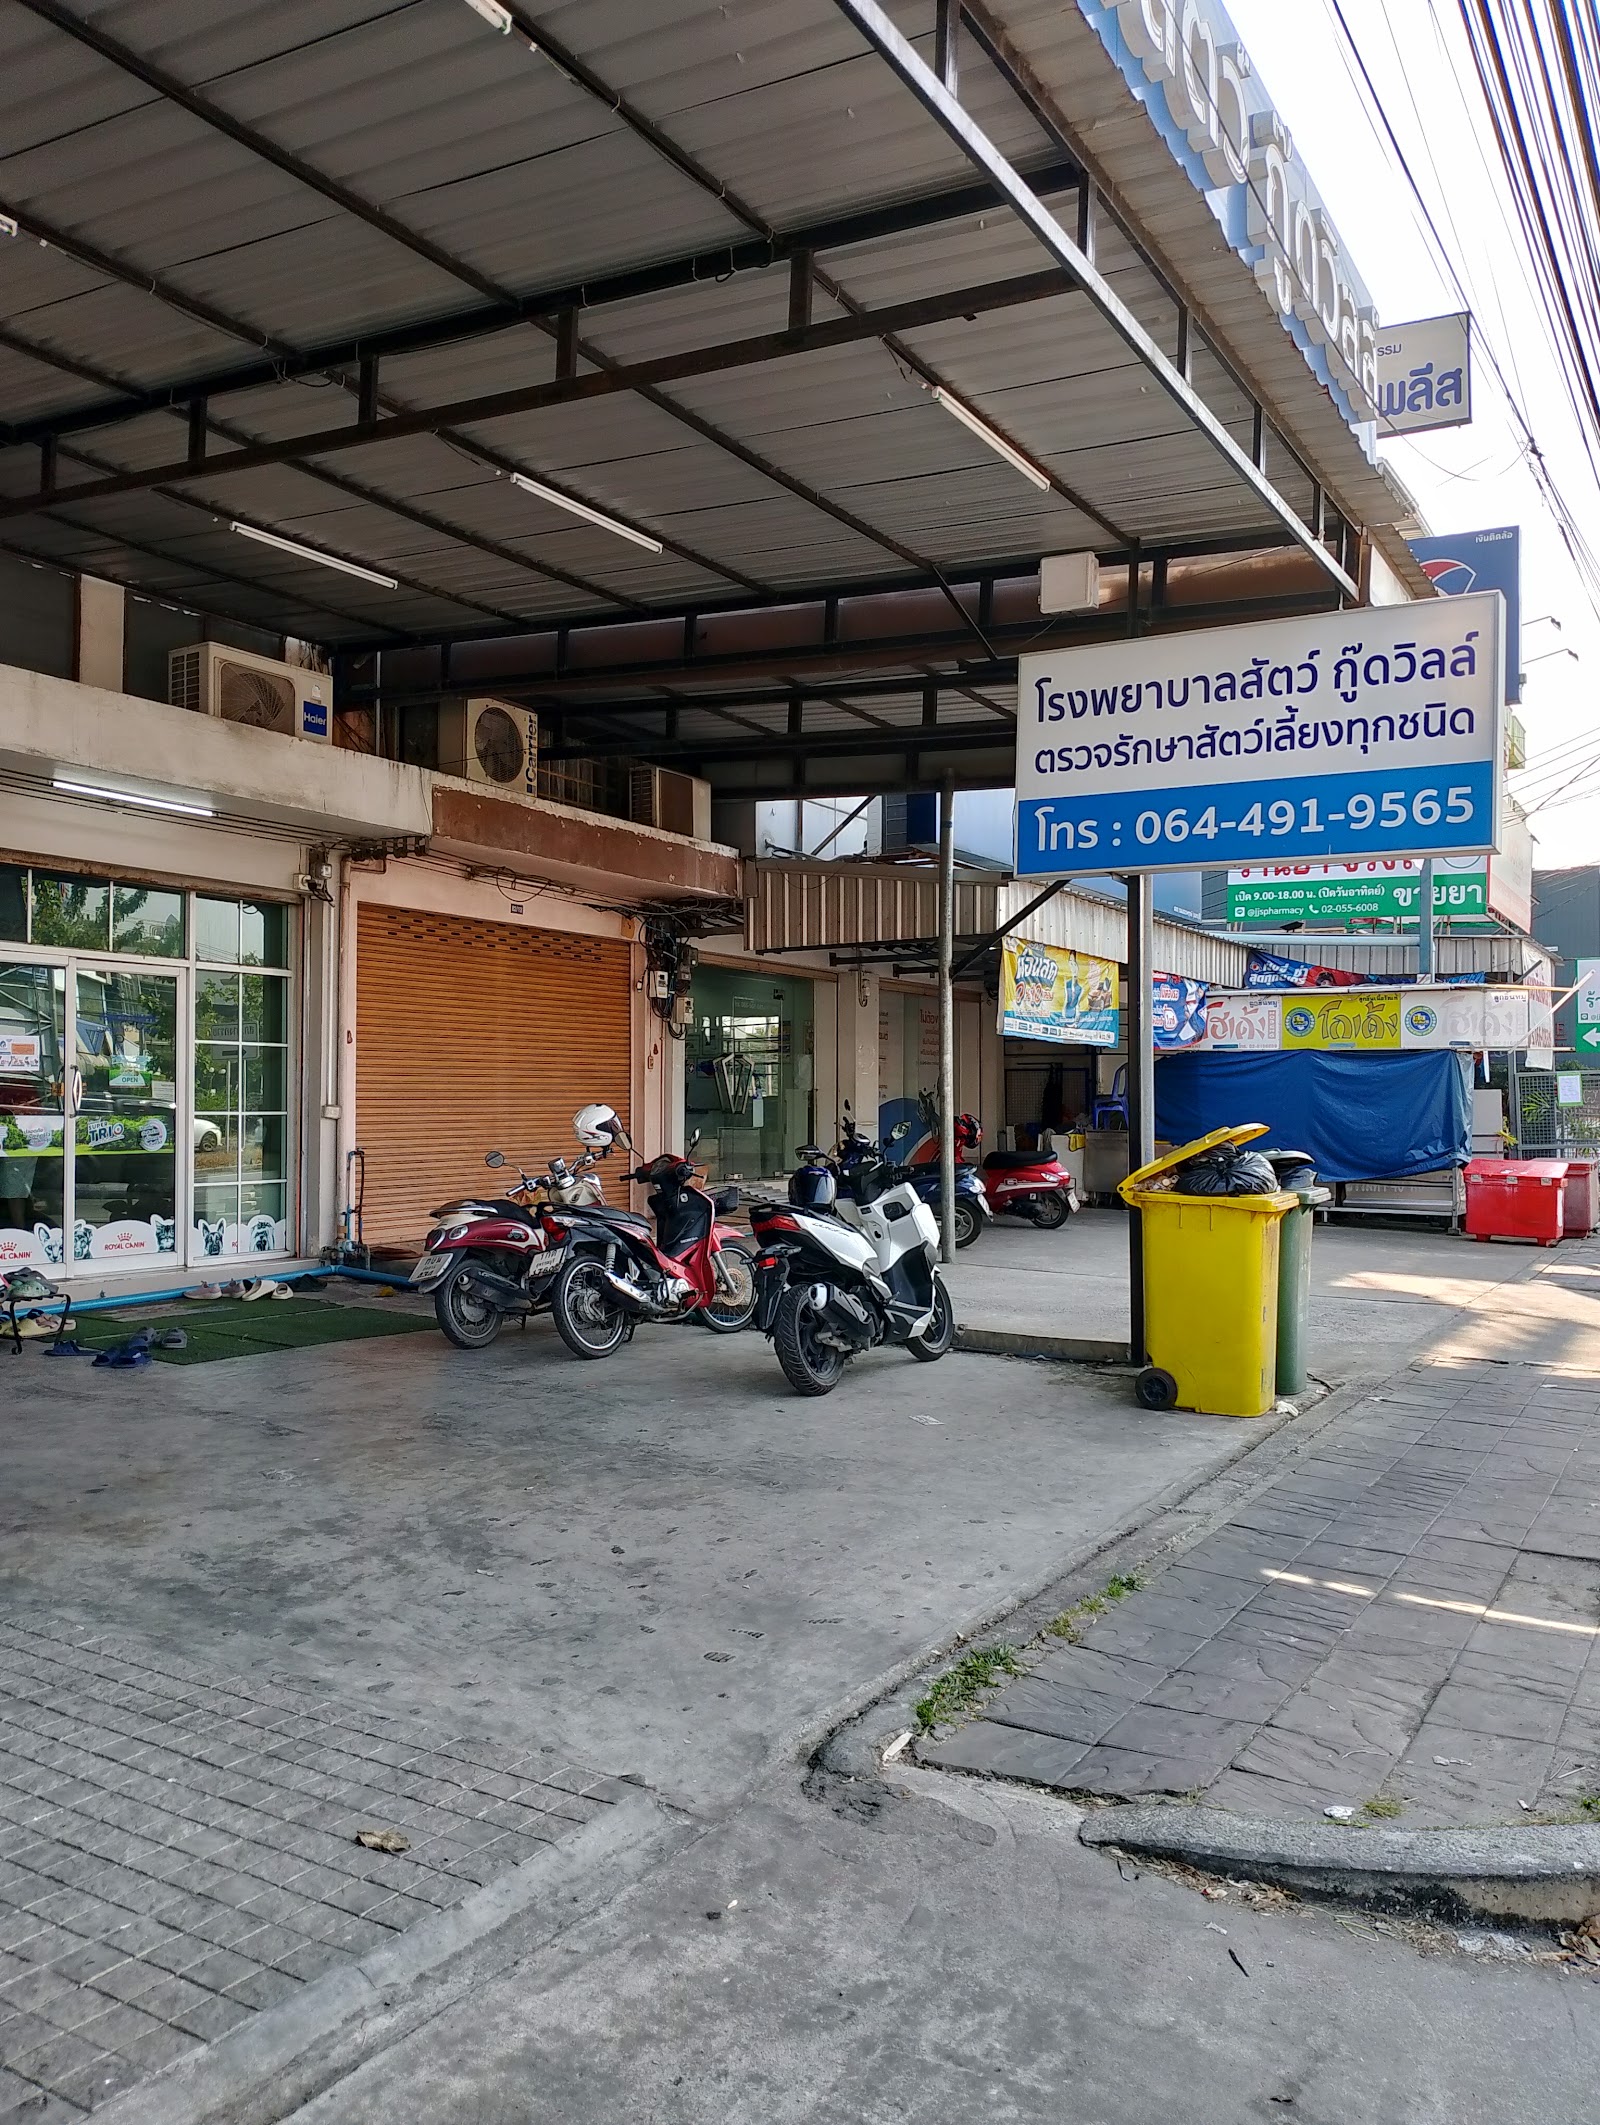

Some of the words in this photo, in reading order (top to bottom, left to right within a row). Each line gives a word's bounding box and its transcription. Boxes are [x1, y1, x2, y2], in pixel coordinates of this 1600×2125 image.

[1034, 649, 1321, 723] โรงพยาบาลสัตว์
[1332, 631, 1481, 703] กู๊ดวิลล์
[303, 711, 327, 726] Haier
[1034, 702, 1476, 774] ตรวจรักษาสัตว์เลี้ยงทุกชนิด
[525, 714, 537, 783] Carrier
[1034, 806, 1100, 852] โทร
[1135, 786, 1475, 846] 064-491-9565
[1253, 890, 1305, 901] 9.00-18.00
[1317, 884, 1385, 899] (ปิดวันอาทิตย์)
[1321, 903, 1379, 914] 02-055-6008
[88, 1122, 108, 1131] SUPER
[89, 1123, 125, 1142] TRIO
[104, 1243, 125, 1251] ROYAL
[126, 1241, 146, 1250] CANIN
[8, 1251, 31, 1260] CANIN
